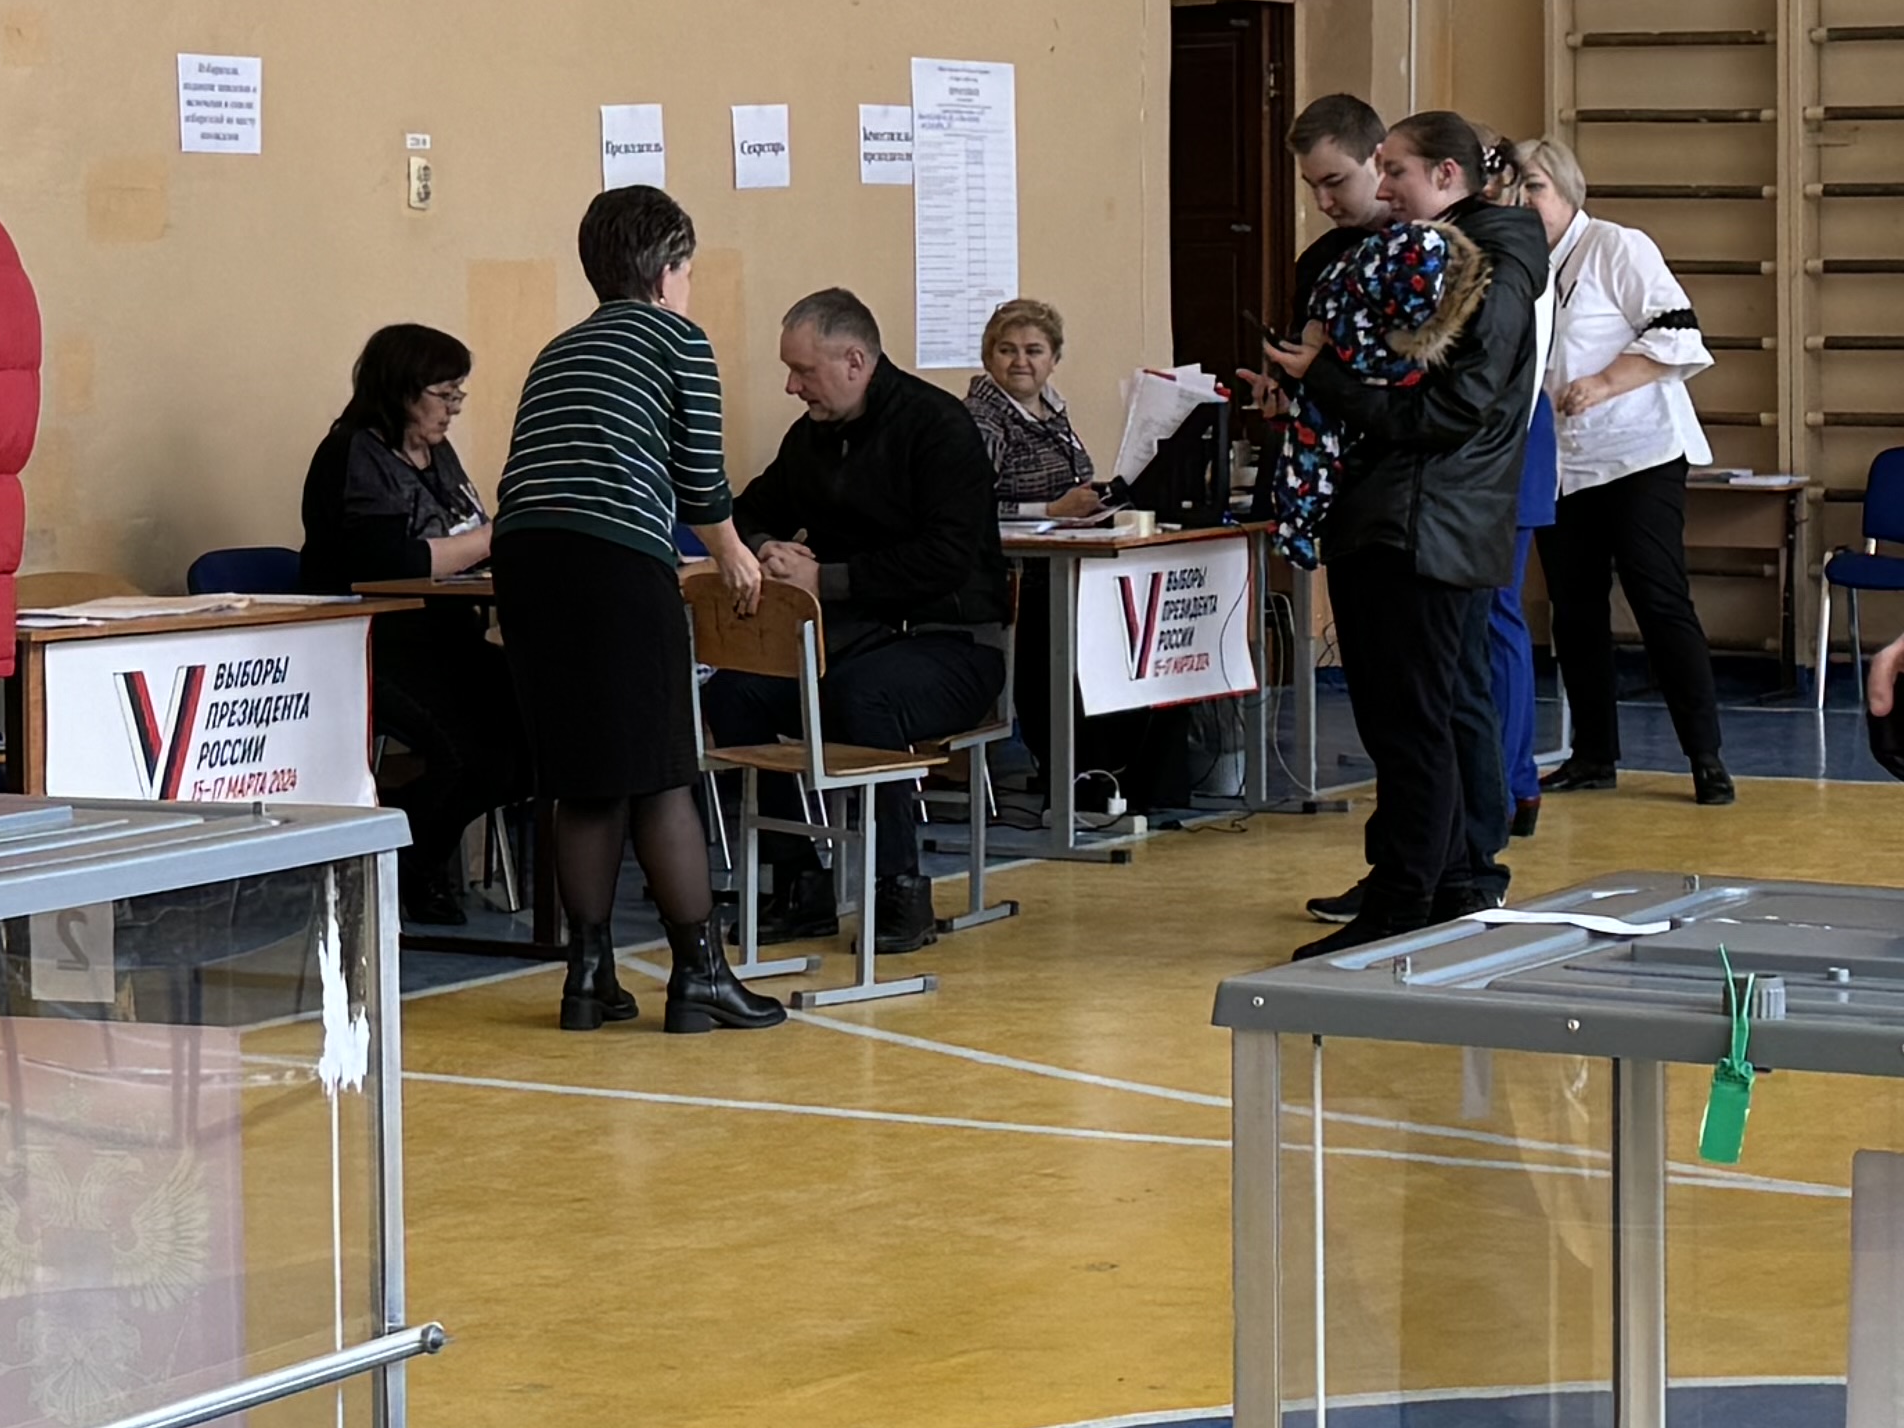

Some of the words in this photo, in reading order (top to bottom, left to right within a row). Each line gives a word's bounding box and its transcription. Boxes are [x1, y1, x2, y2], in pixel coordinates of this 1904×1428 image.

[214, 656, 289, 690] ВЫБОРЫ
[206, 692, 310, 729] ПРЕЗИДЕНТА
[197, 735, 266, 769] РОССИИ
[226, 775, 267, 797] МАРТА
[269, 769, 296, 794] 2024
